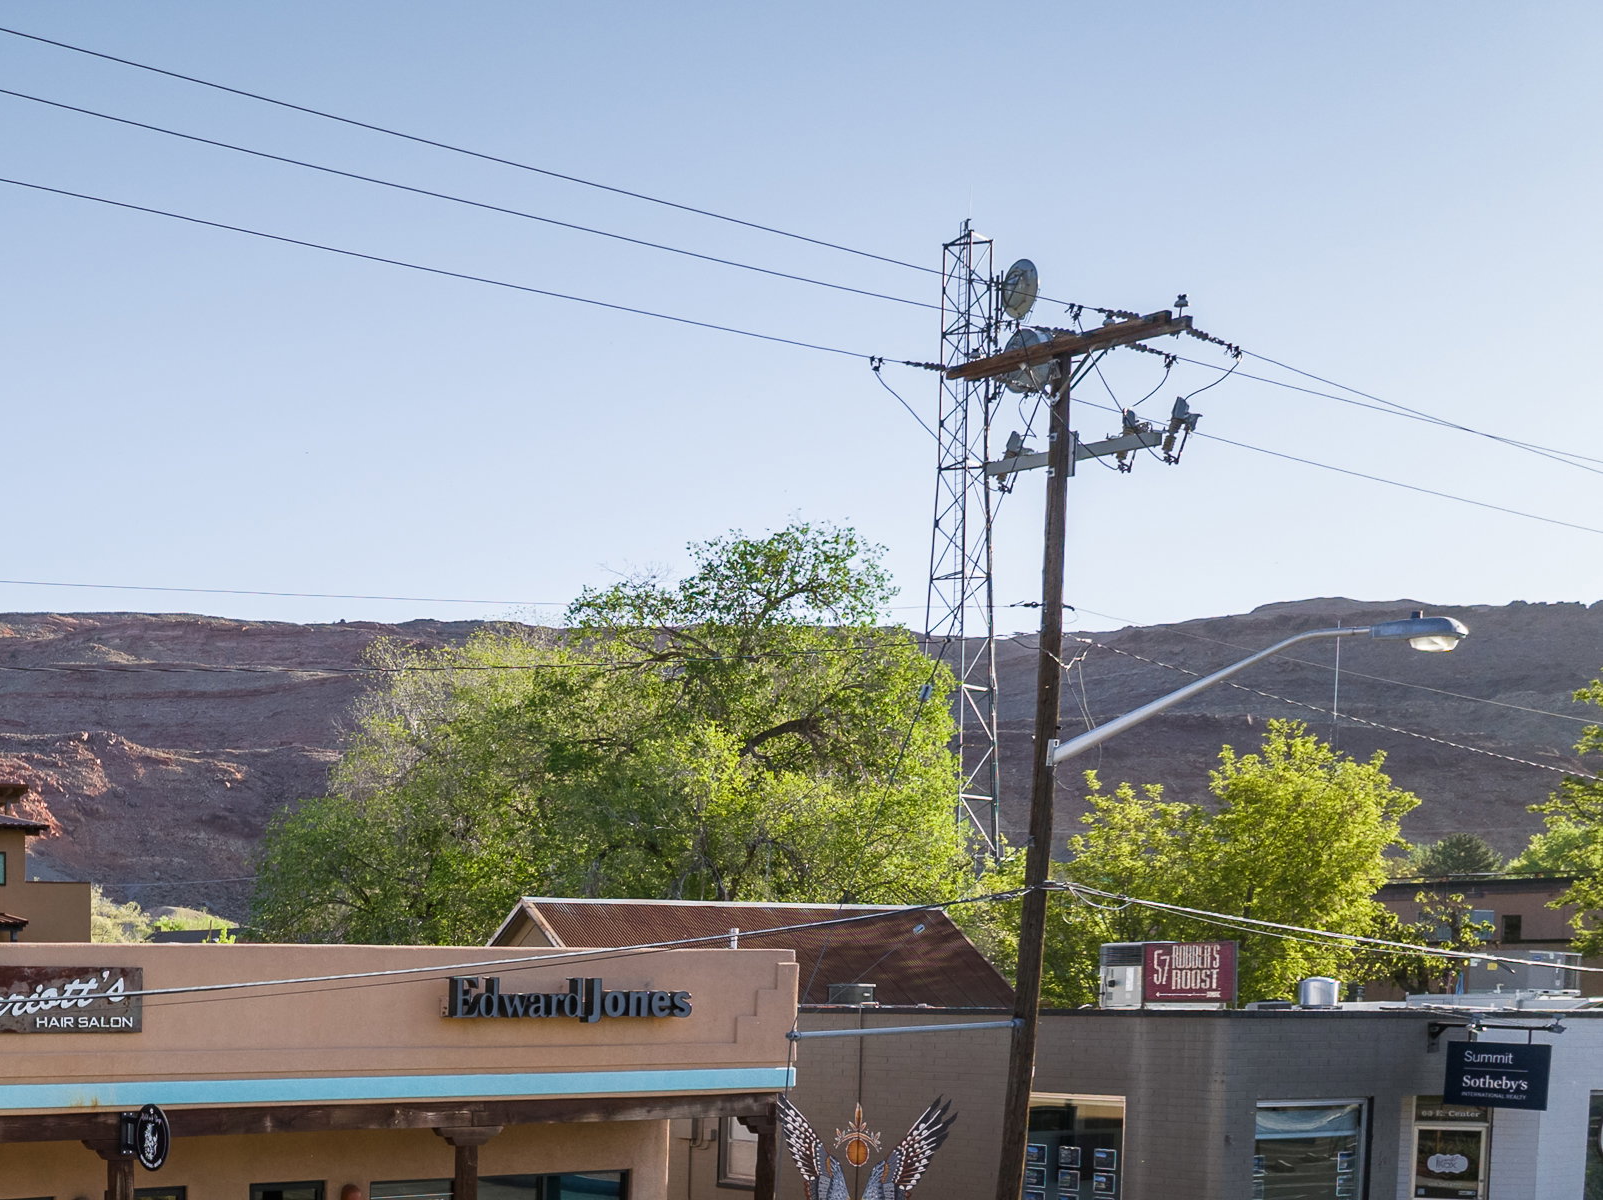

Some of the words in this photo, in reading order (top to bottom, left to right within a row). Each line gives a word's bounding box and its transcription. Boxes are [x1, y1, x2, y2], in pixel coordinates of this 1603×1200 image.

[1172, 944, 1221, 969] ROBBER'S
[1153, 949, 1170, 985] 57
[1171, 968, 1220, 990] ROOST
[36, 1016, 74, 1028] HAIR
[78, 1016, 133, 1028] SALON
[1464, 1050, 1514, 1064] Summit
[1462, 1075, 1528, 1092] Sotheby's
[1461, 1091, 1504, 1099] INTERNATIONAL
[1448, 1110, 1481, 1118] Center
